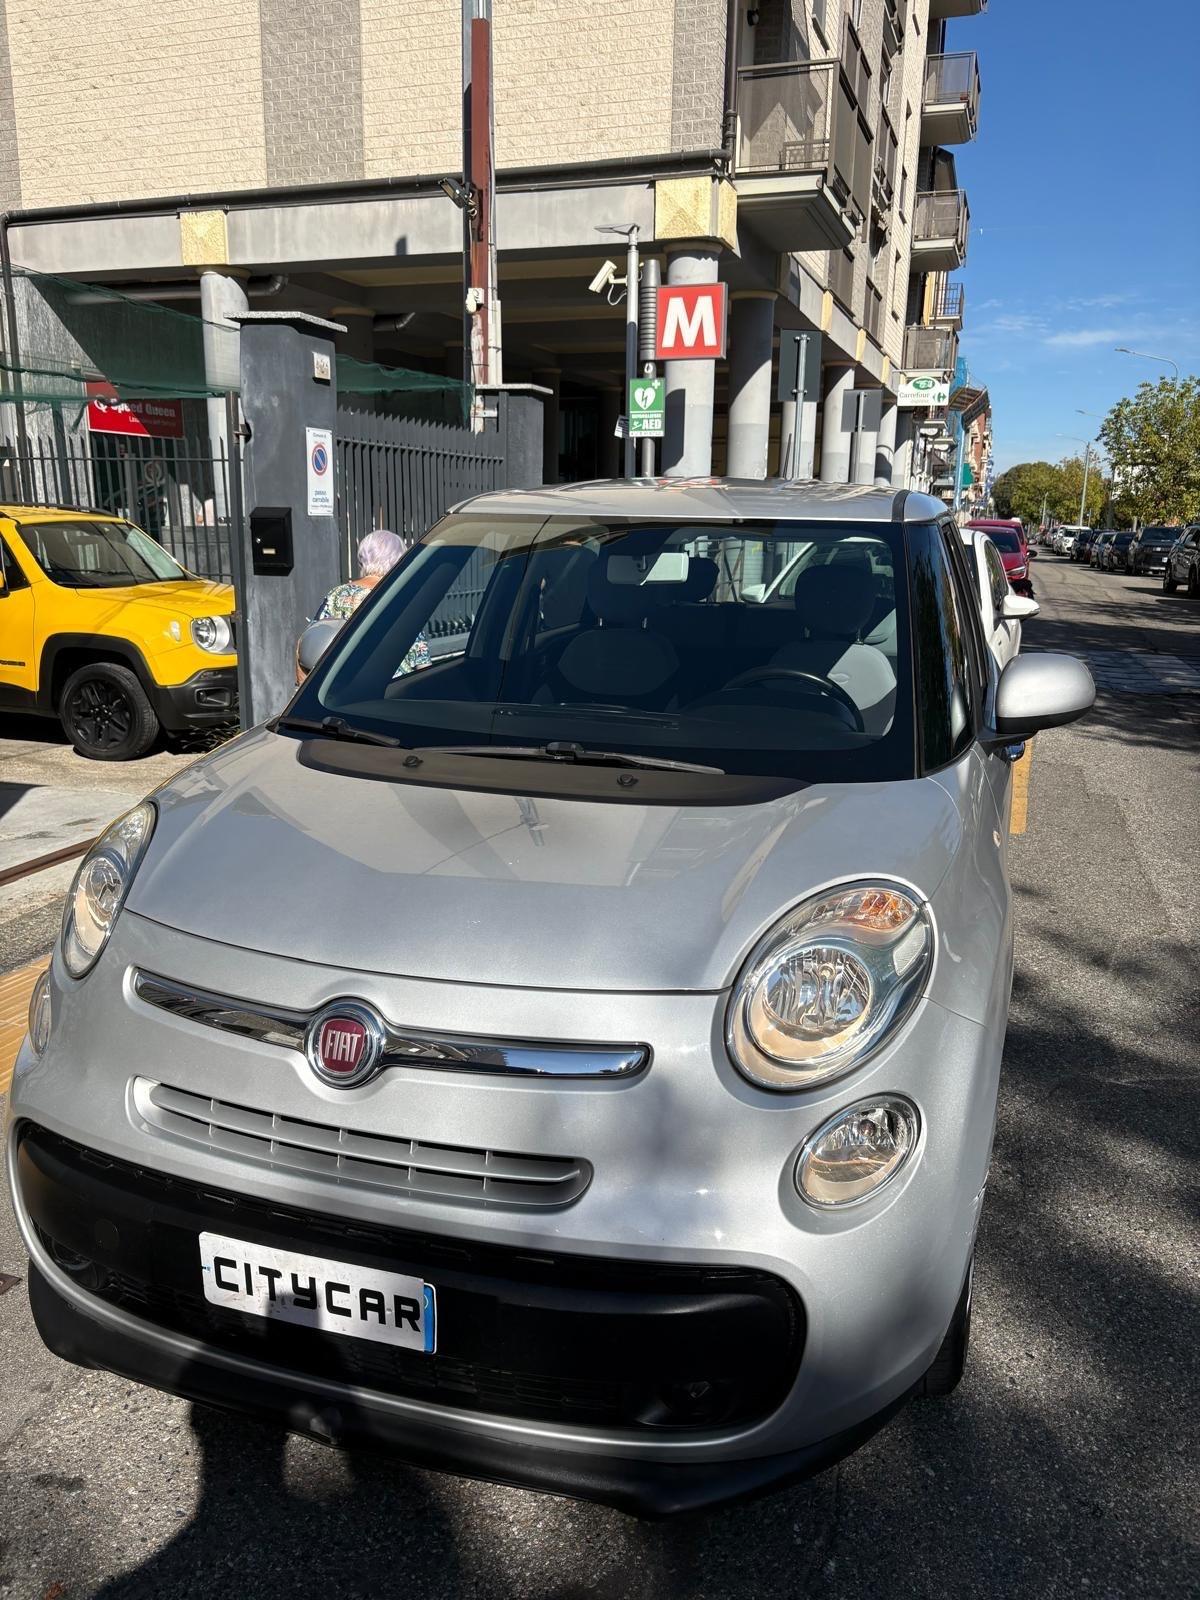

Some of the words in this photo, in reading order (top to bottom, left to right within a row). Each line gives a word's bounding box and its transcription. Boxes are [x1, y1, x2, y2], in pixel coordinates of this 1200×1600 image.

[661, 296, 717, 348] M
[642, 419, 662, 430] AED
[324, 1029, 361, 1062] FIAT
[213, 1256, 421, 1332] CITYCAR
